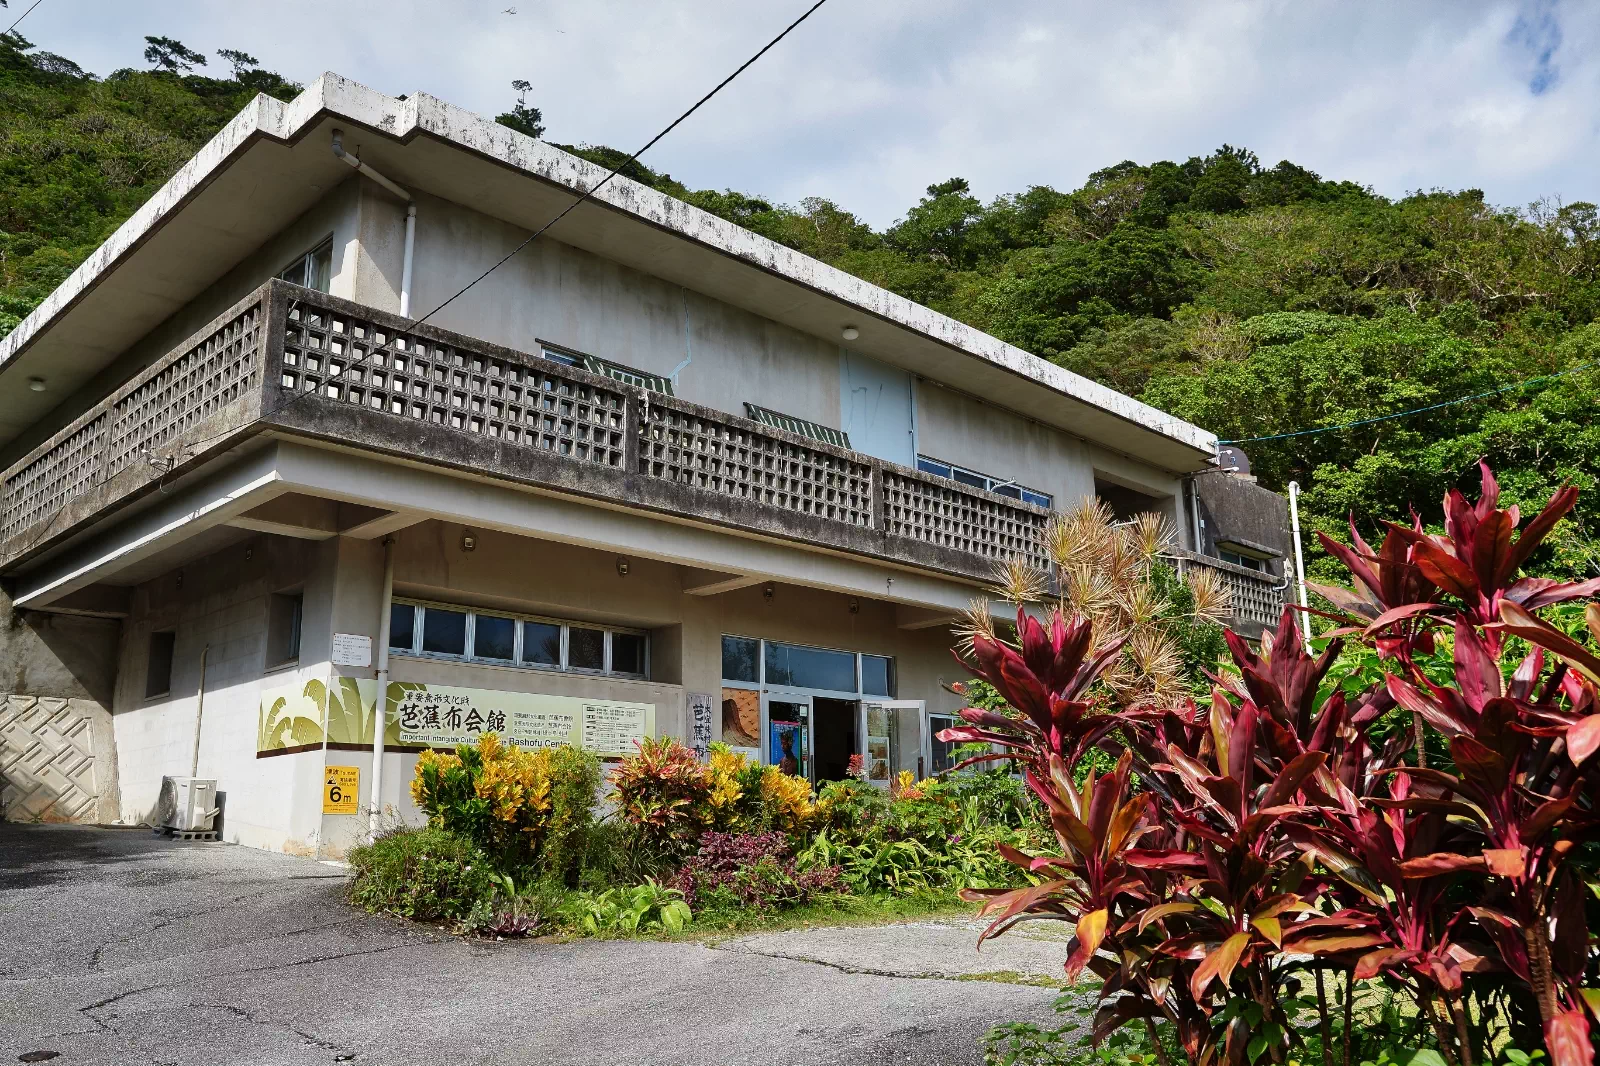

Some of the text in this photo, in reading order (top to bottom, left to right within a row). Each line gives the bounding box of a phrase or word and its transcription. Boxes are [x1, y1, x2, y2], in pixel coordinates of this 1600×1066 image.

[400, 702, 507, 734] 芭蕉布会館
[401, 733, 479, 744] Important Intangible Cultur
[509, 737, 543, 748] Bashofu
[330, 786, 352, 803] 6 m
